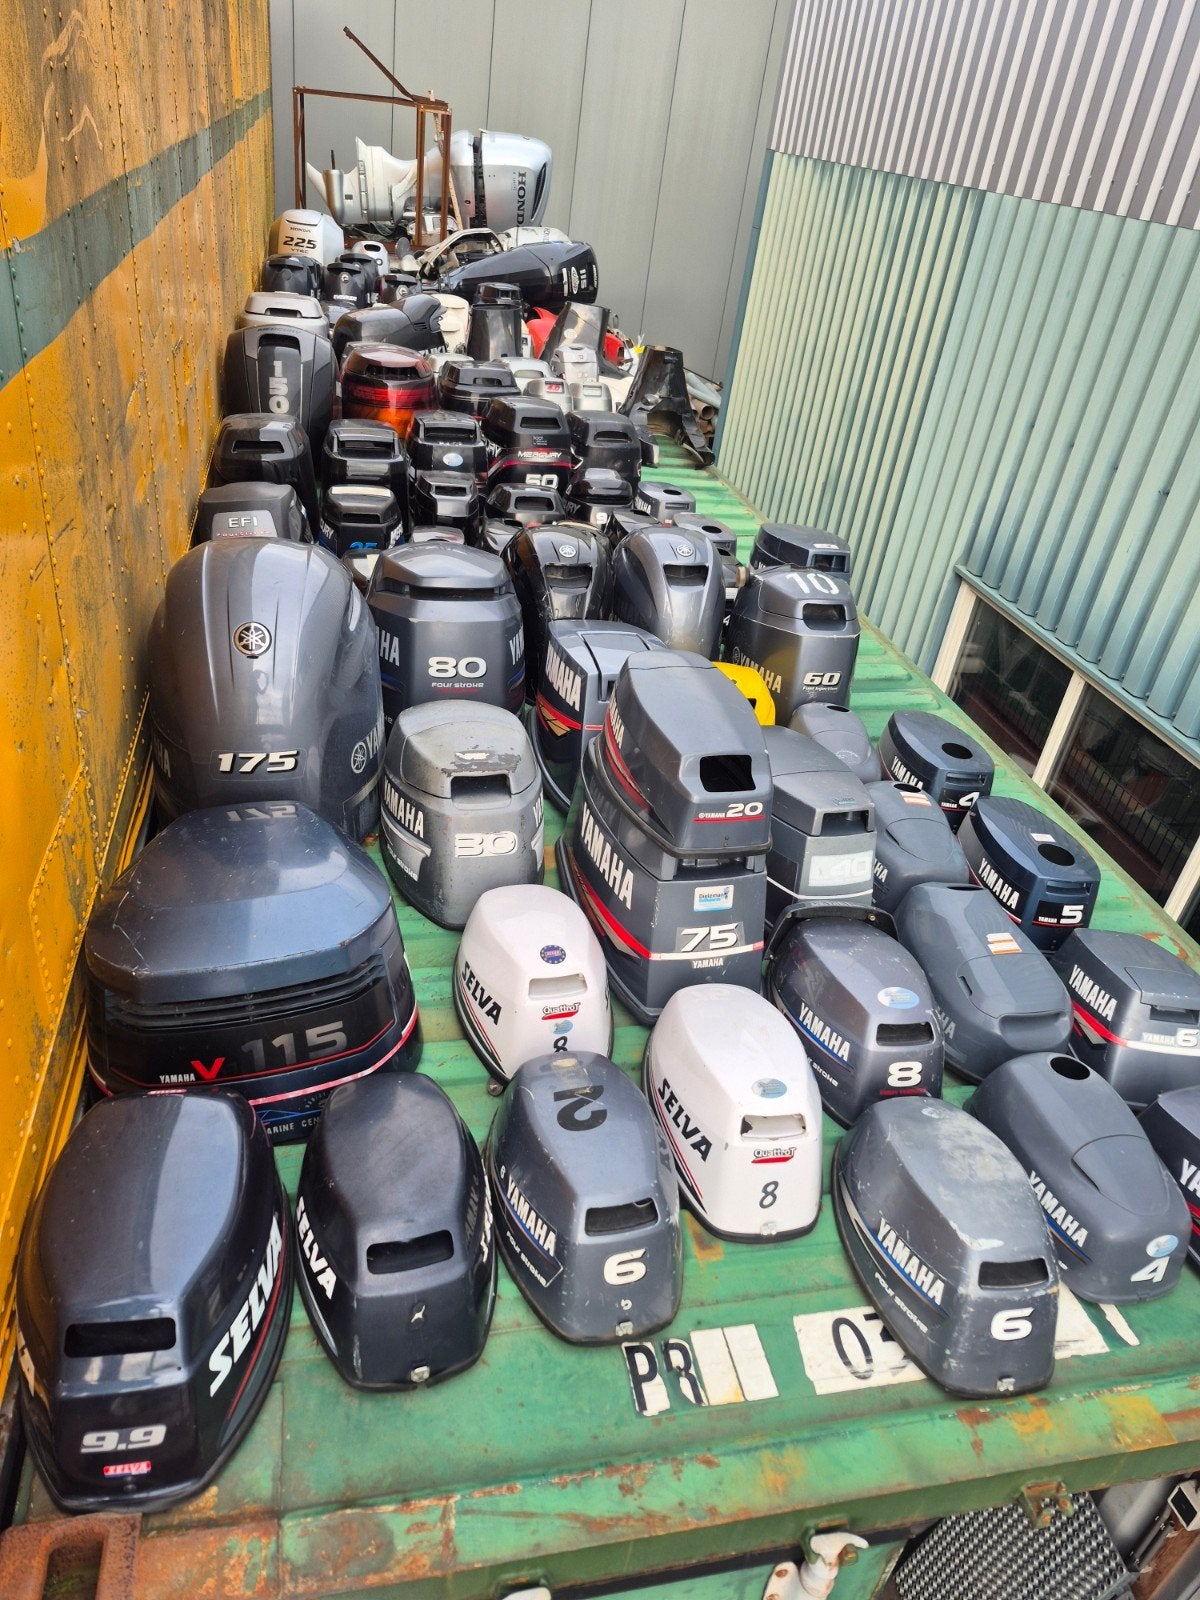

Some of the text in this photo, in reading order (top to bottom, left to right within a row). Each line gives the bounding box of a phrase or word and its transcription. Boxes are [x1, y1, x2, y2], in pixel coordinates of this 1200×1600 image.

[517, 171, 527, 228] HOND
[283, 236, 317, 250] 225
[269, 360, 290, 414] 150
[517, 450, 562, 459] MERCURY
[525, 473, 559, 489] 50
[228, 516, 258, 528] EFI
[785, 572, 839, 595] 10
[428, 656, 487, 679] 80
[802, 671, 841, 686] 60
[217, 750, 299, 773] 175
[891, 755, 924, 790] YAMAHA
[384, 776, 424, 839] YAMAHA
[726, 802, 764, 818] 20
[455, 830, 518, 859] 30
[581, 801, 634, 911] YAMAHA
[977, 857, 1020, 911] YAMAHA
[1060, 904, 1084, 925] 5
[680, 922, 739, 953] 75
[692, 957, 724, 969] YAMAHA
[461, 960, 502, 1026] SELVA
[1068, 964, 1118, 1022] YAMAHA
[240, 1020, 348, 1072] 115
[799, 1002, 851, 1062] YAMAHA
[1176, 1028, 1200, 1047] 6
[159, 1073, 196, 1084] YAMAHA
[887, 1061, 923, 1088] 8
[553, 1084, 608, 1132] 2
[657, 1077, 713, 1163] SELVA
[266, 1122, 296, 1135] ARINE
[759, 1180, 779, 1209] 8
[1029, 1169, 1089, 1248] YAMAHA
[507, 1173, 557, 1258] YAMAHA
[296, 1196, 337, 1300] SELVA
[877, 1217, 945, 1306] YAMAHA
[603, 1248, 647, 1286] 6
[1130, 1255, 1170, 1283] 4
[208, 1215, 282, 1398] SELVA
[990, 1307, 1035, 1342] 6
[80, 1423, 167, 1453] 9.9
[107, 1461, 149, 1475] SELVA
